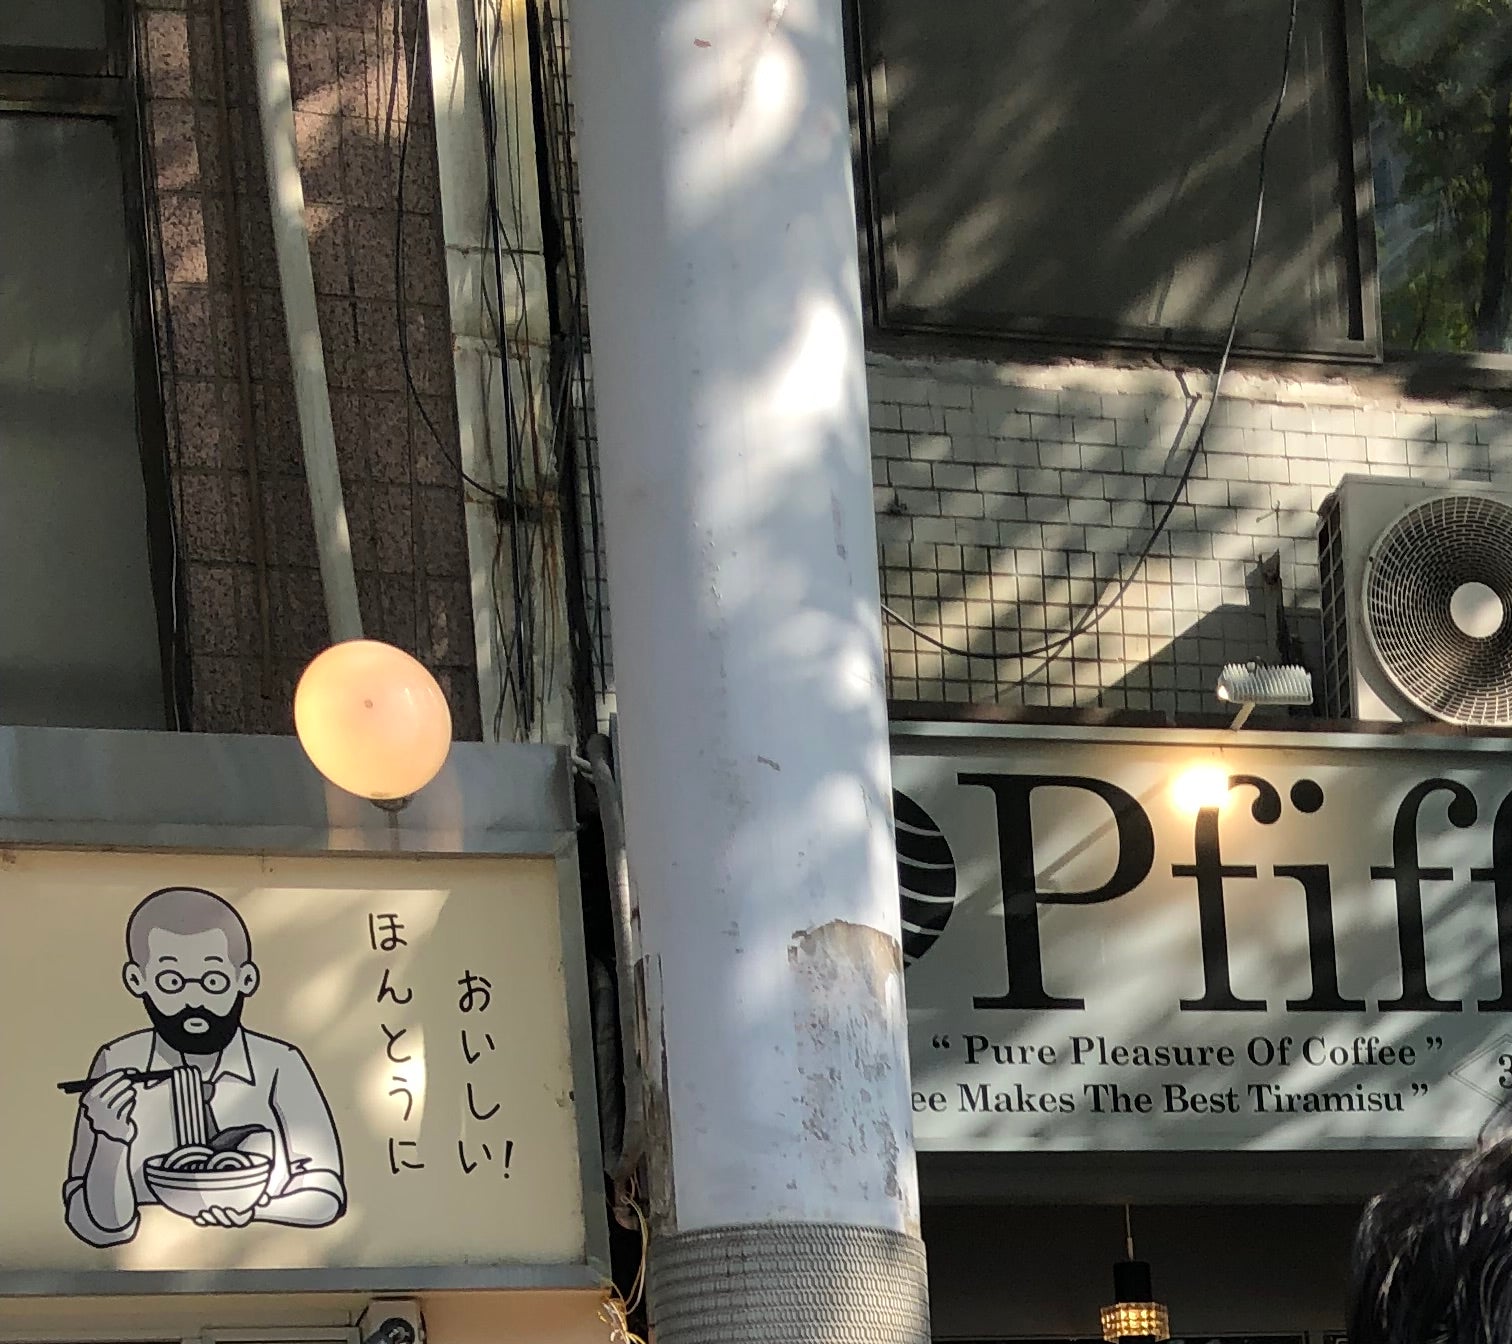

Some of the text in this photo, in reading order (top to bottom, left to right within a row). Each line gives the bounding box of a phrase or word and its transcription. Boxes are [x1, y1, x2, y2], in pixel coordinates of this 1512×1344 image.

[369, 911, 424, 1174] ほんとうに
[457, 969, 514, 1179] おいしい!
[957, 1083, 1076, 1114] Makes
[1084, 1083, 1154, 1114] The
[1162, 1083, 1240, 1114] Best
[1069, 1035, 1236, 1067] Pleasure
[1247, 1036, 1294, 1067] Of
